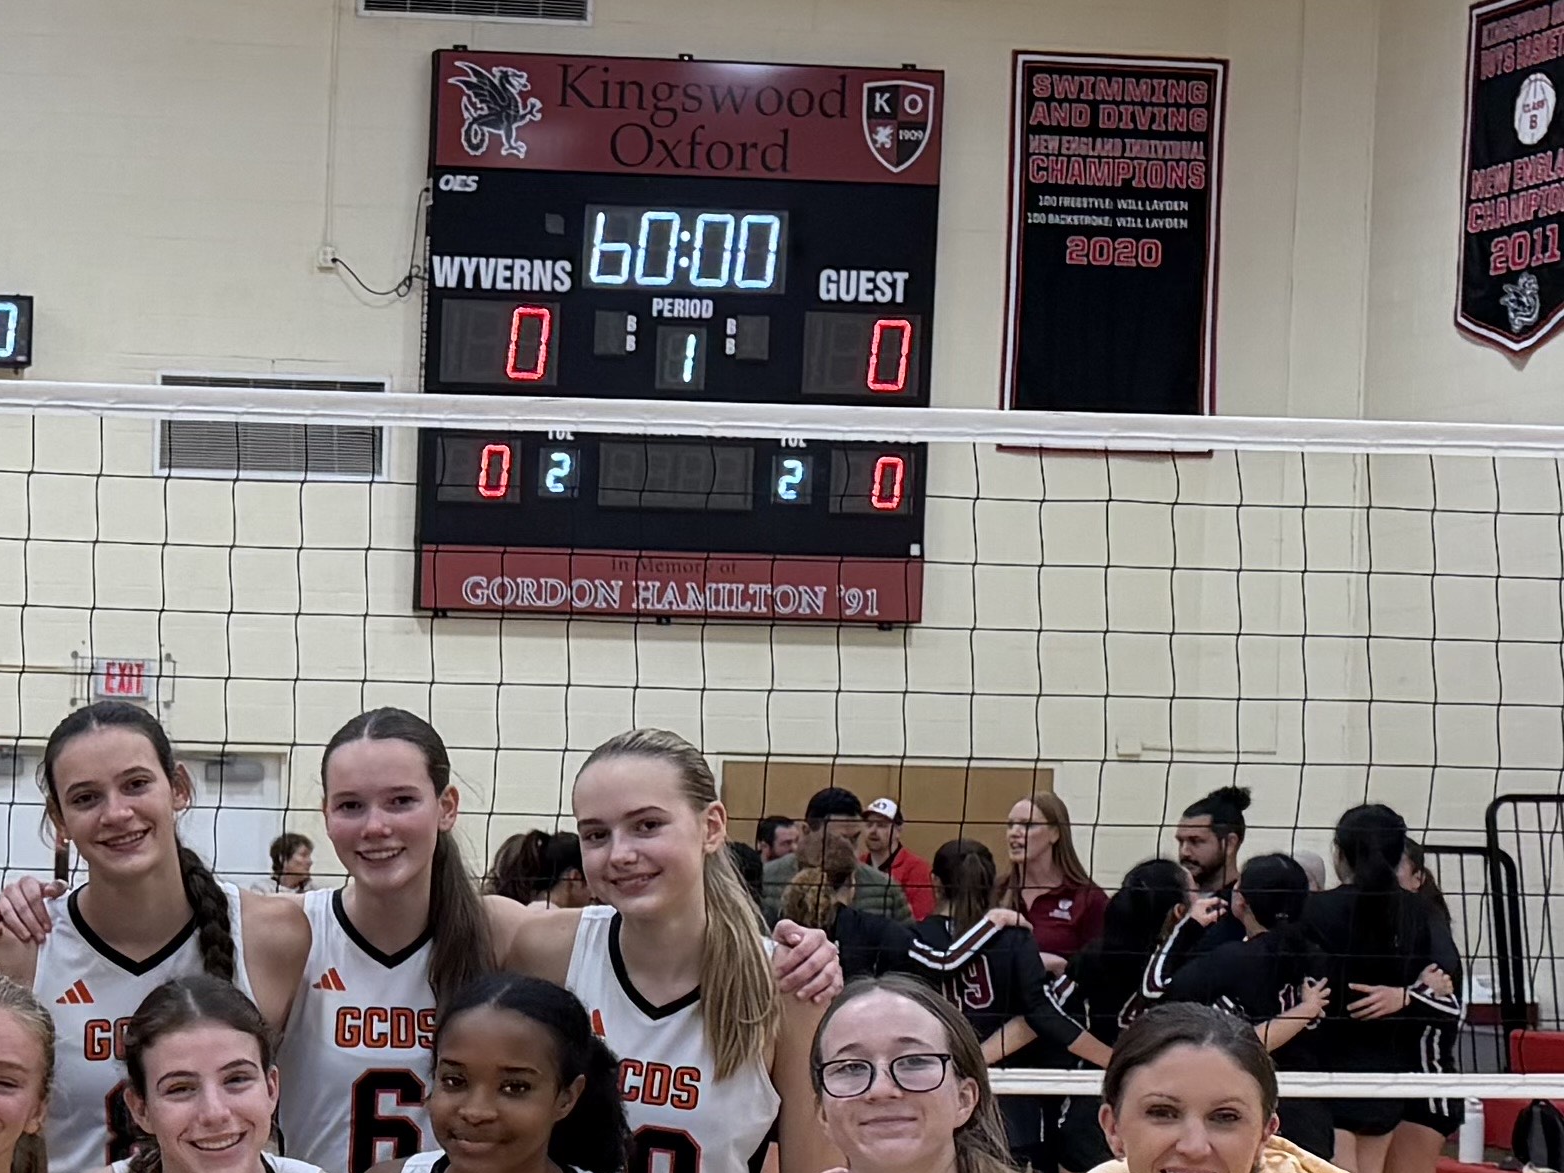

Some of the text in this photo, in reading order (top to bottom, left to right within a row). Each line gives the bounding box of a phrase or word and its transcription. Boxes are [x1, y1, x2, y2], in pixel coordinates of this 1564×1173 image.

[557, 63, 849, 129] Kingswood
[874, 92, 923, 115] K O
[1033, 73, 1208, 104] SWIMMING
[899, 129, 924, 140] 1909
[1029, 101, 1208, 132] AND DIVING
[610, 122, 791, 174] Oxford
[1029, 134, 1059, 154] NEW
[439, 175, 479, 193] OES
[1029, 155, 1206, 189] CHAMPIONS
[1470, 162, 1512, 199] NEW
[589, 211, 780, 290] 60:00
[1066, 235, 1162, 268] 2020
[1489, 224, 1561, 276] 2011
[432, 255, 572, 293] WYVERNS
[819, 269, 909, 304] GUEST
[652, 298, 714, 319] PERIOD
[505, 305, 552, 381] 0
[683, 334, 696, 383] 1
[866, 319, 913, 392] 0
[478, 444, 511, 497] 0
[546, 452, 571, 493] 2
[778, 459, 804, 500] 2
[871, 456, 904, 509] 0
[637, 558, 709, 574] Memor
[462, 575, 880, 617] GORDON HAMILTON '91
[105, 661, 144, 695] EXIT
[335, 1006, 437, 1049] GCDS
[617, 1057, 702, 1110] CDS
